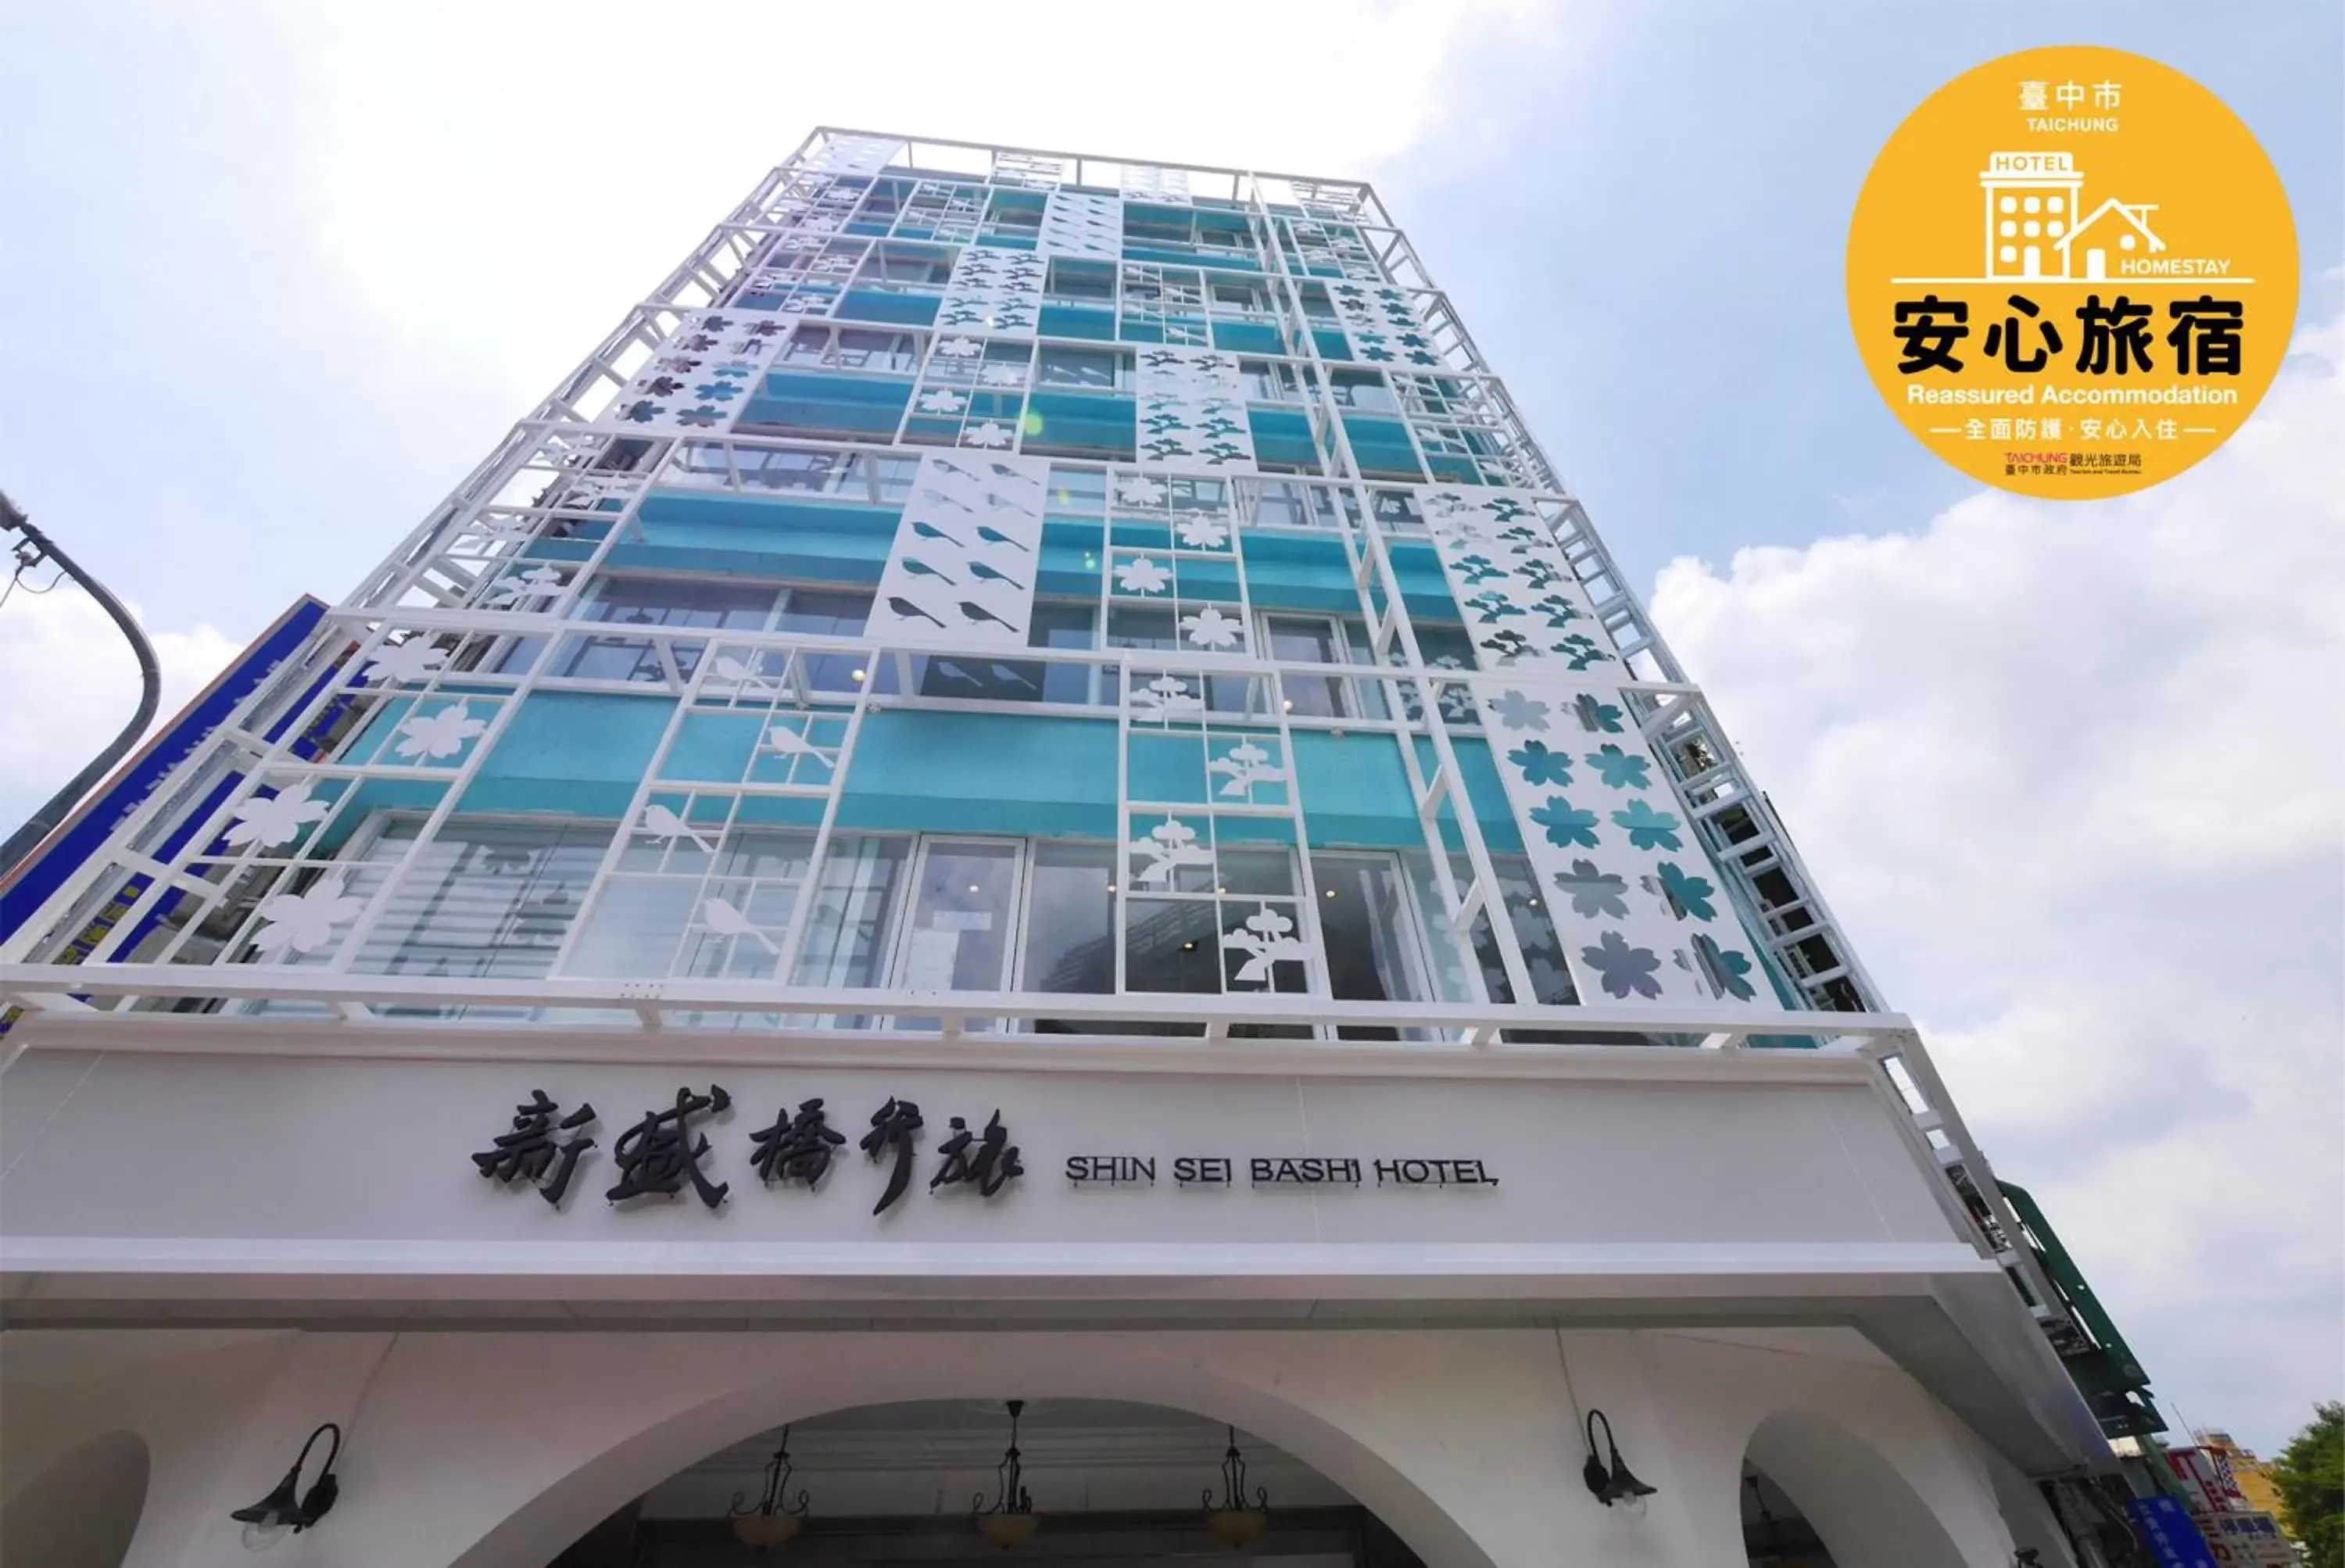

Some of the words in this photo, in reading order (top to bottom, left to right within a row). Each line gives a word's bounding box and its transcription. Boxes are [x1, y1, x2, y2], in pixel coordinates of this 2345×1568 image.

[1065, 1156, 1155, 1182] SHIN
[1173, 1158, 1231, 1183] SEI
[1251, 1158, 1362, 1183] BASHI
[1373, 1159, 1497, 1185] HOTEL
